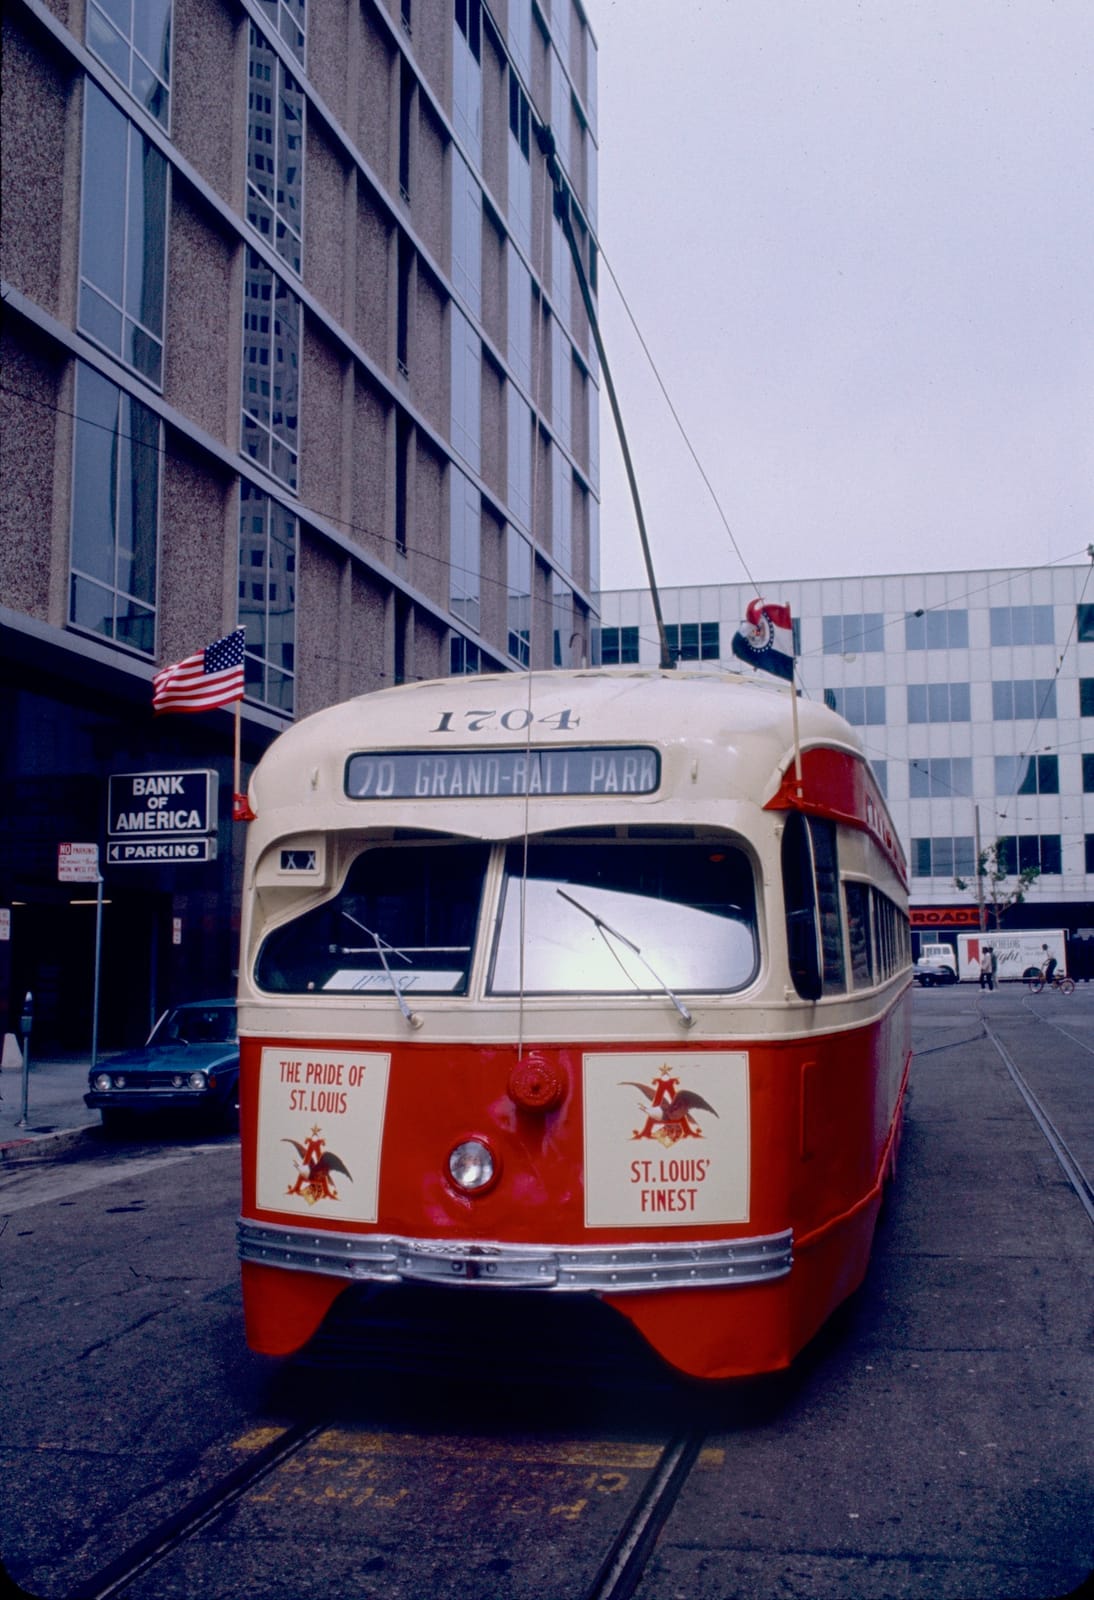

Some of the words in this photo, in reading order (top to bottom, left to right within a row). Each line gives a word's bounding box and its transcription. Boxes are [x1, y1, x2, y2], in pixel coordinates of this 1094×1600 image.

[429, 708, 581, 733] 1704
[132, 776, 185, 796] BANK
[358, 760, 395, 796] 70
[590, 755, 656, 793] PARK
[147, 797, 169, 809] OF
[115, 810, 201, 831] AMERICA
[124, 845, 200, 859] PARKING
[279, 1061, 302, 1083] THE
[305, 1063, 344, 1086] PRIDE
[348, 1066, 366, 1087] OF
[289, 1089, 307, 1111] ST.
[310, 1091, 347, 1114] LOUIS
[630, 1161, 656, 1184] ST.
[659, 1159, 711, 1183] LOUIS'
[641, 1189, 698, 1212] FINEST
